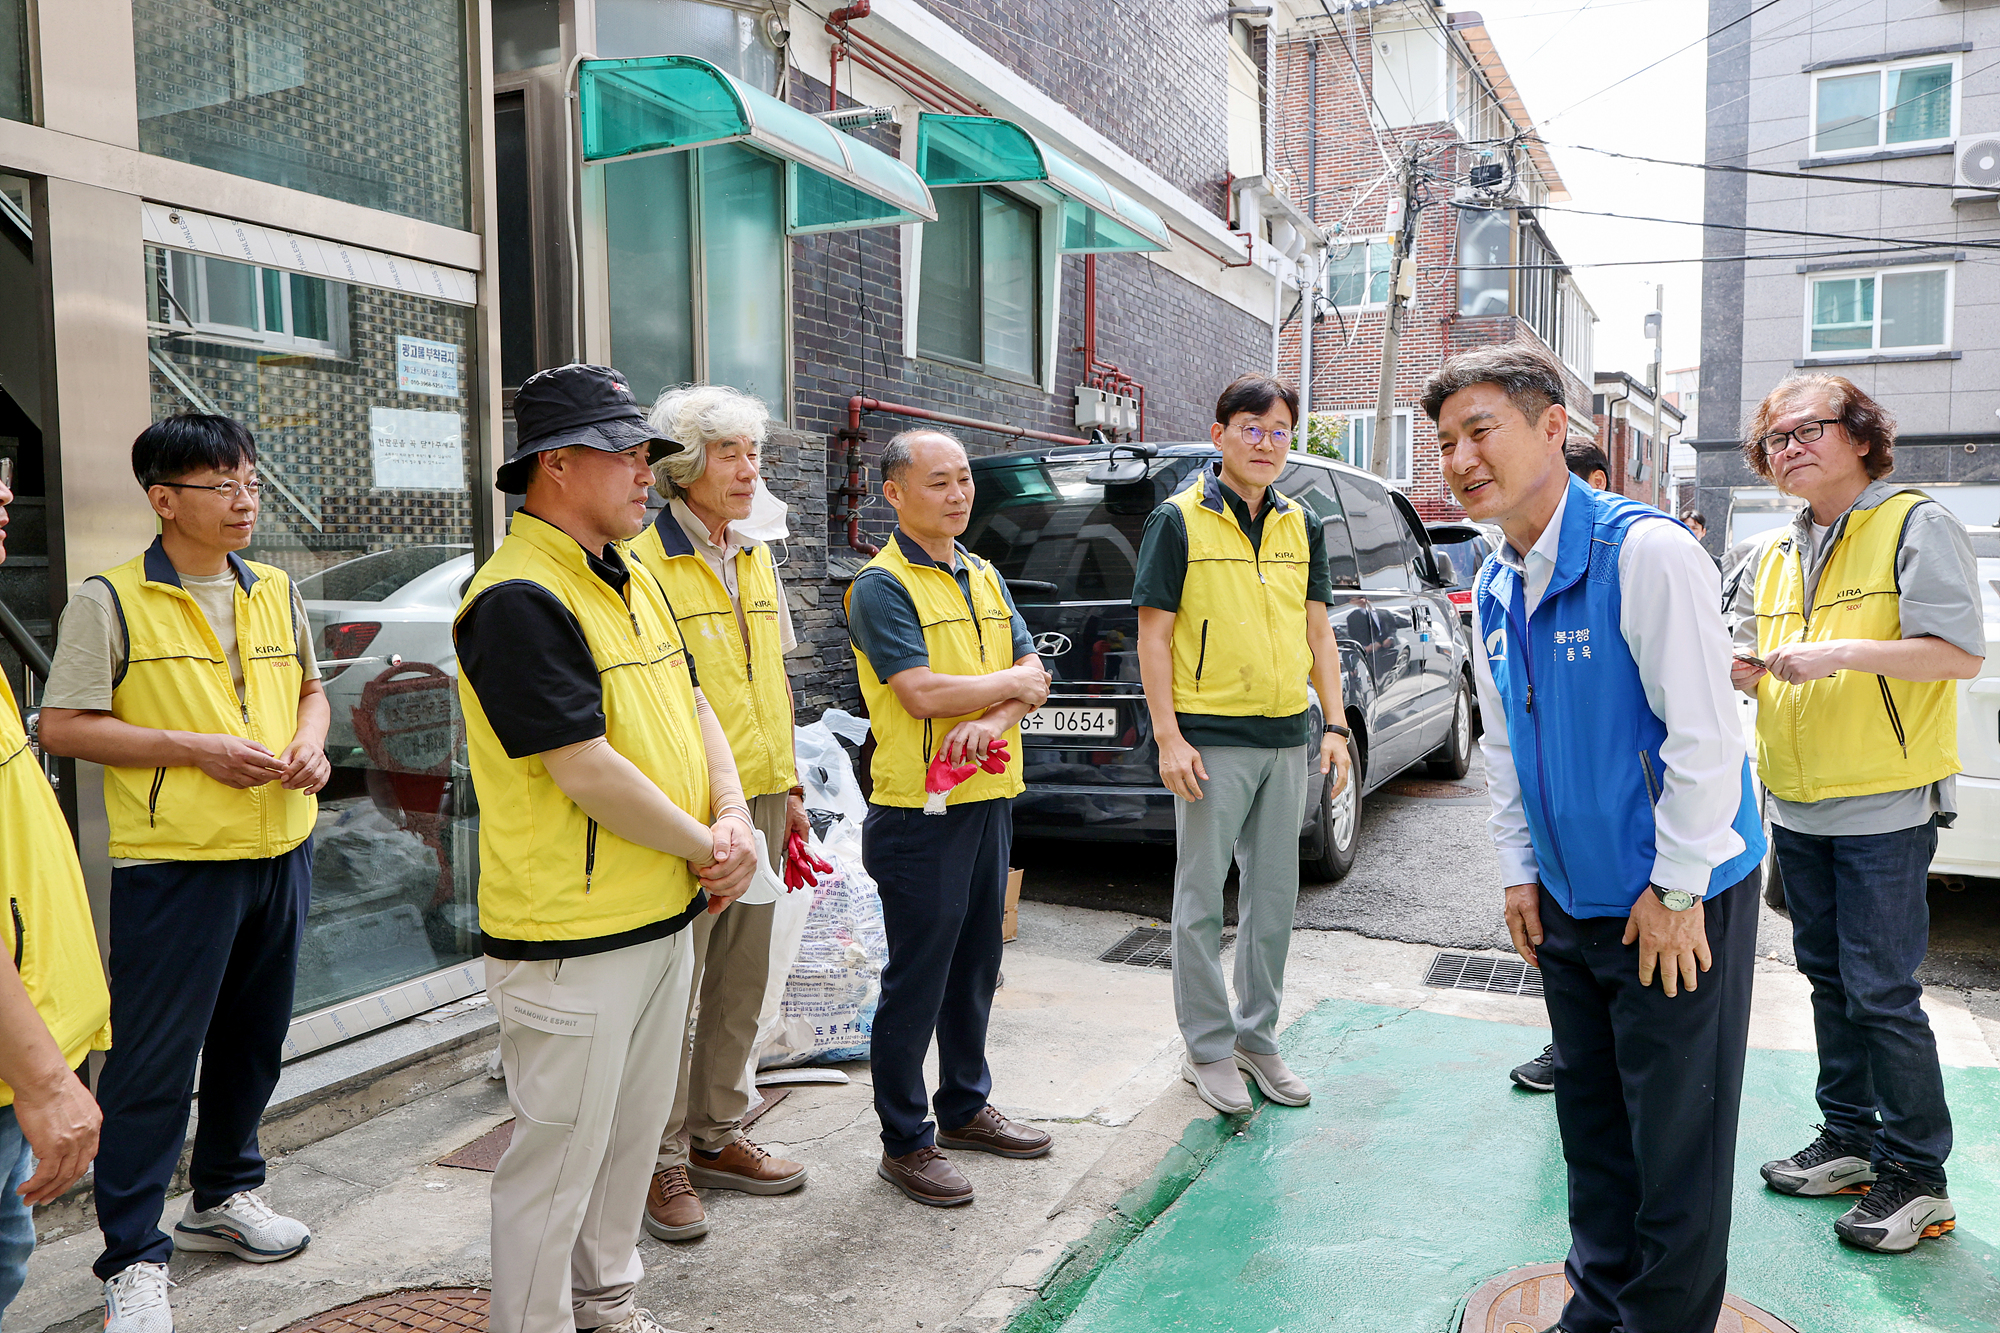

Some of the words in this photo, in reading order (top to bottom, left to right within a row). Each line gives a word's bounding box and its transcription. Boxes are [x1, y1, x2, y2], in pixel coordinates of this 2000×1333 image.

[432, 270, 447, 298] TAINLESS
[402, 344, 425, 359] 광고물
[426, 347, 454, 365] 부착금지
[378, 439, 405, 447] 현관문을
[410, 440, 416, 448] 꼭
[1274, 551, 1295, 559] KIRA
[1836, 588, 1862, 599] KIRA
[1554, 628, 1590, 644] 봉구청장
[255, 645, 283, 653] KIRA
[1054, 711, 1105, 732] 0654
[514, 1006, 549, 1023] CHAMONIX
[550, 1017, 579, 1027] ESPRIT
